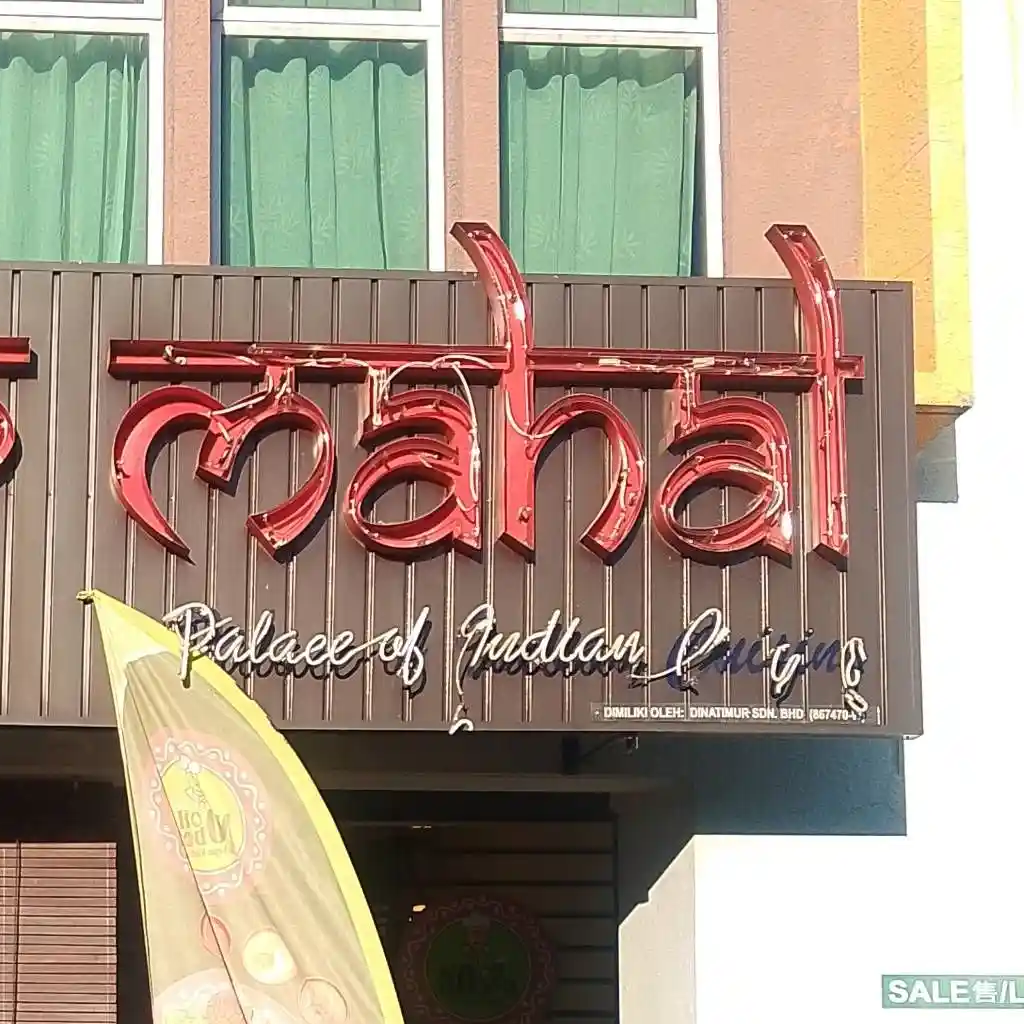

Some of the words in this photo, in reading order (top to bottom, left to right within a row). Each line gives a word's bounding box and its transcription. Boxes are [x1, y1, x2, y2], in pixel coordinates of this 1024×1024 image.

[108, 223, 865, 570] mahal
[163, 602, 359, 688] Palace
[377, 605, 431, 688] of
[603, 706, 648, 719] DIMILIKI
[650, 706, 685, 719] OLEH:
[689, 706, 749, 720] DINATIMUR
[779, 707, 805, 720] BHD
[808, 708, 866, 723] (867470-
